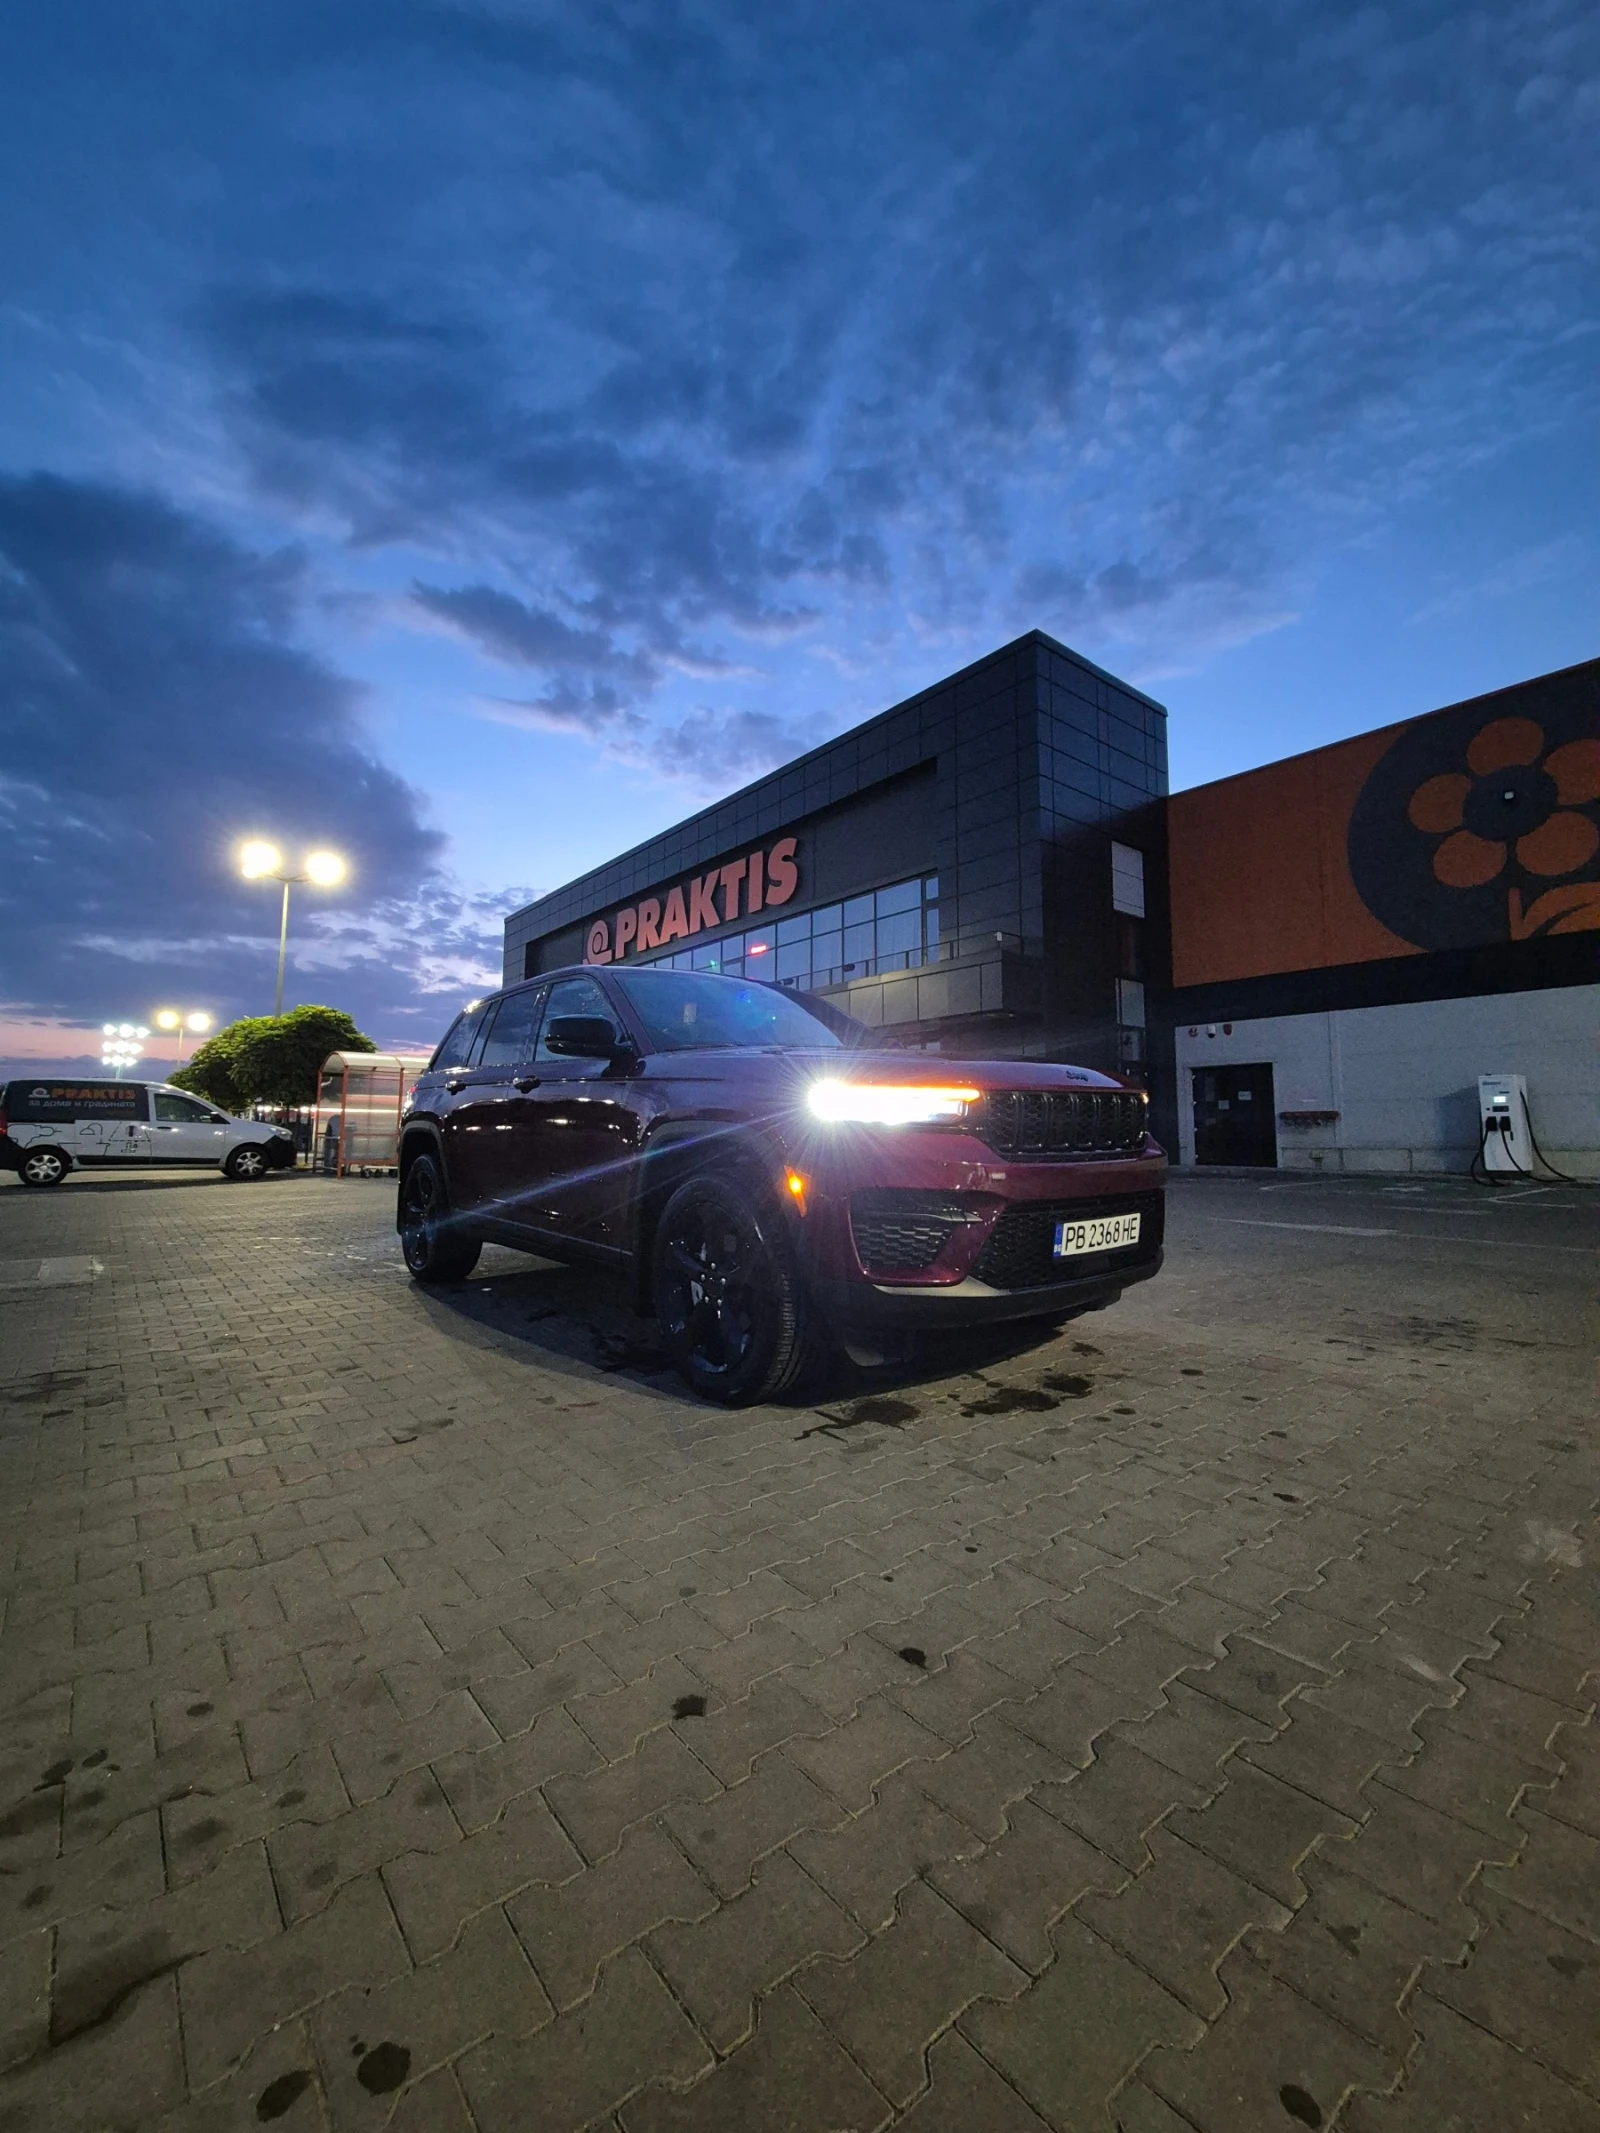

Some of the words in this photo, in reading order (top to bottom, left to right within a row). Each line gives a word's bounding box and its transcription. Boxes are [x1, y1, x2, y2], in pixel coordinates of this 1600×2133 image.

[614, 837, 798, 960] PRAKTIS
[51, 1088, 136, 1100] PRAKTIS
[1065, 1225, 1086, 1252] PB
[1088, 1220, 1120, 1248] 2368
[1121, 1217, 1138, 1242] HE
